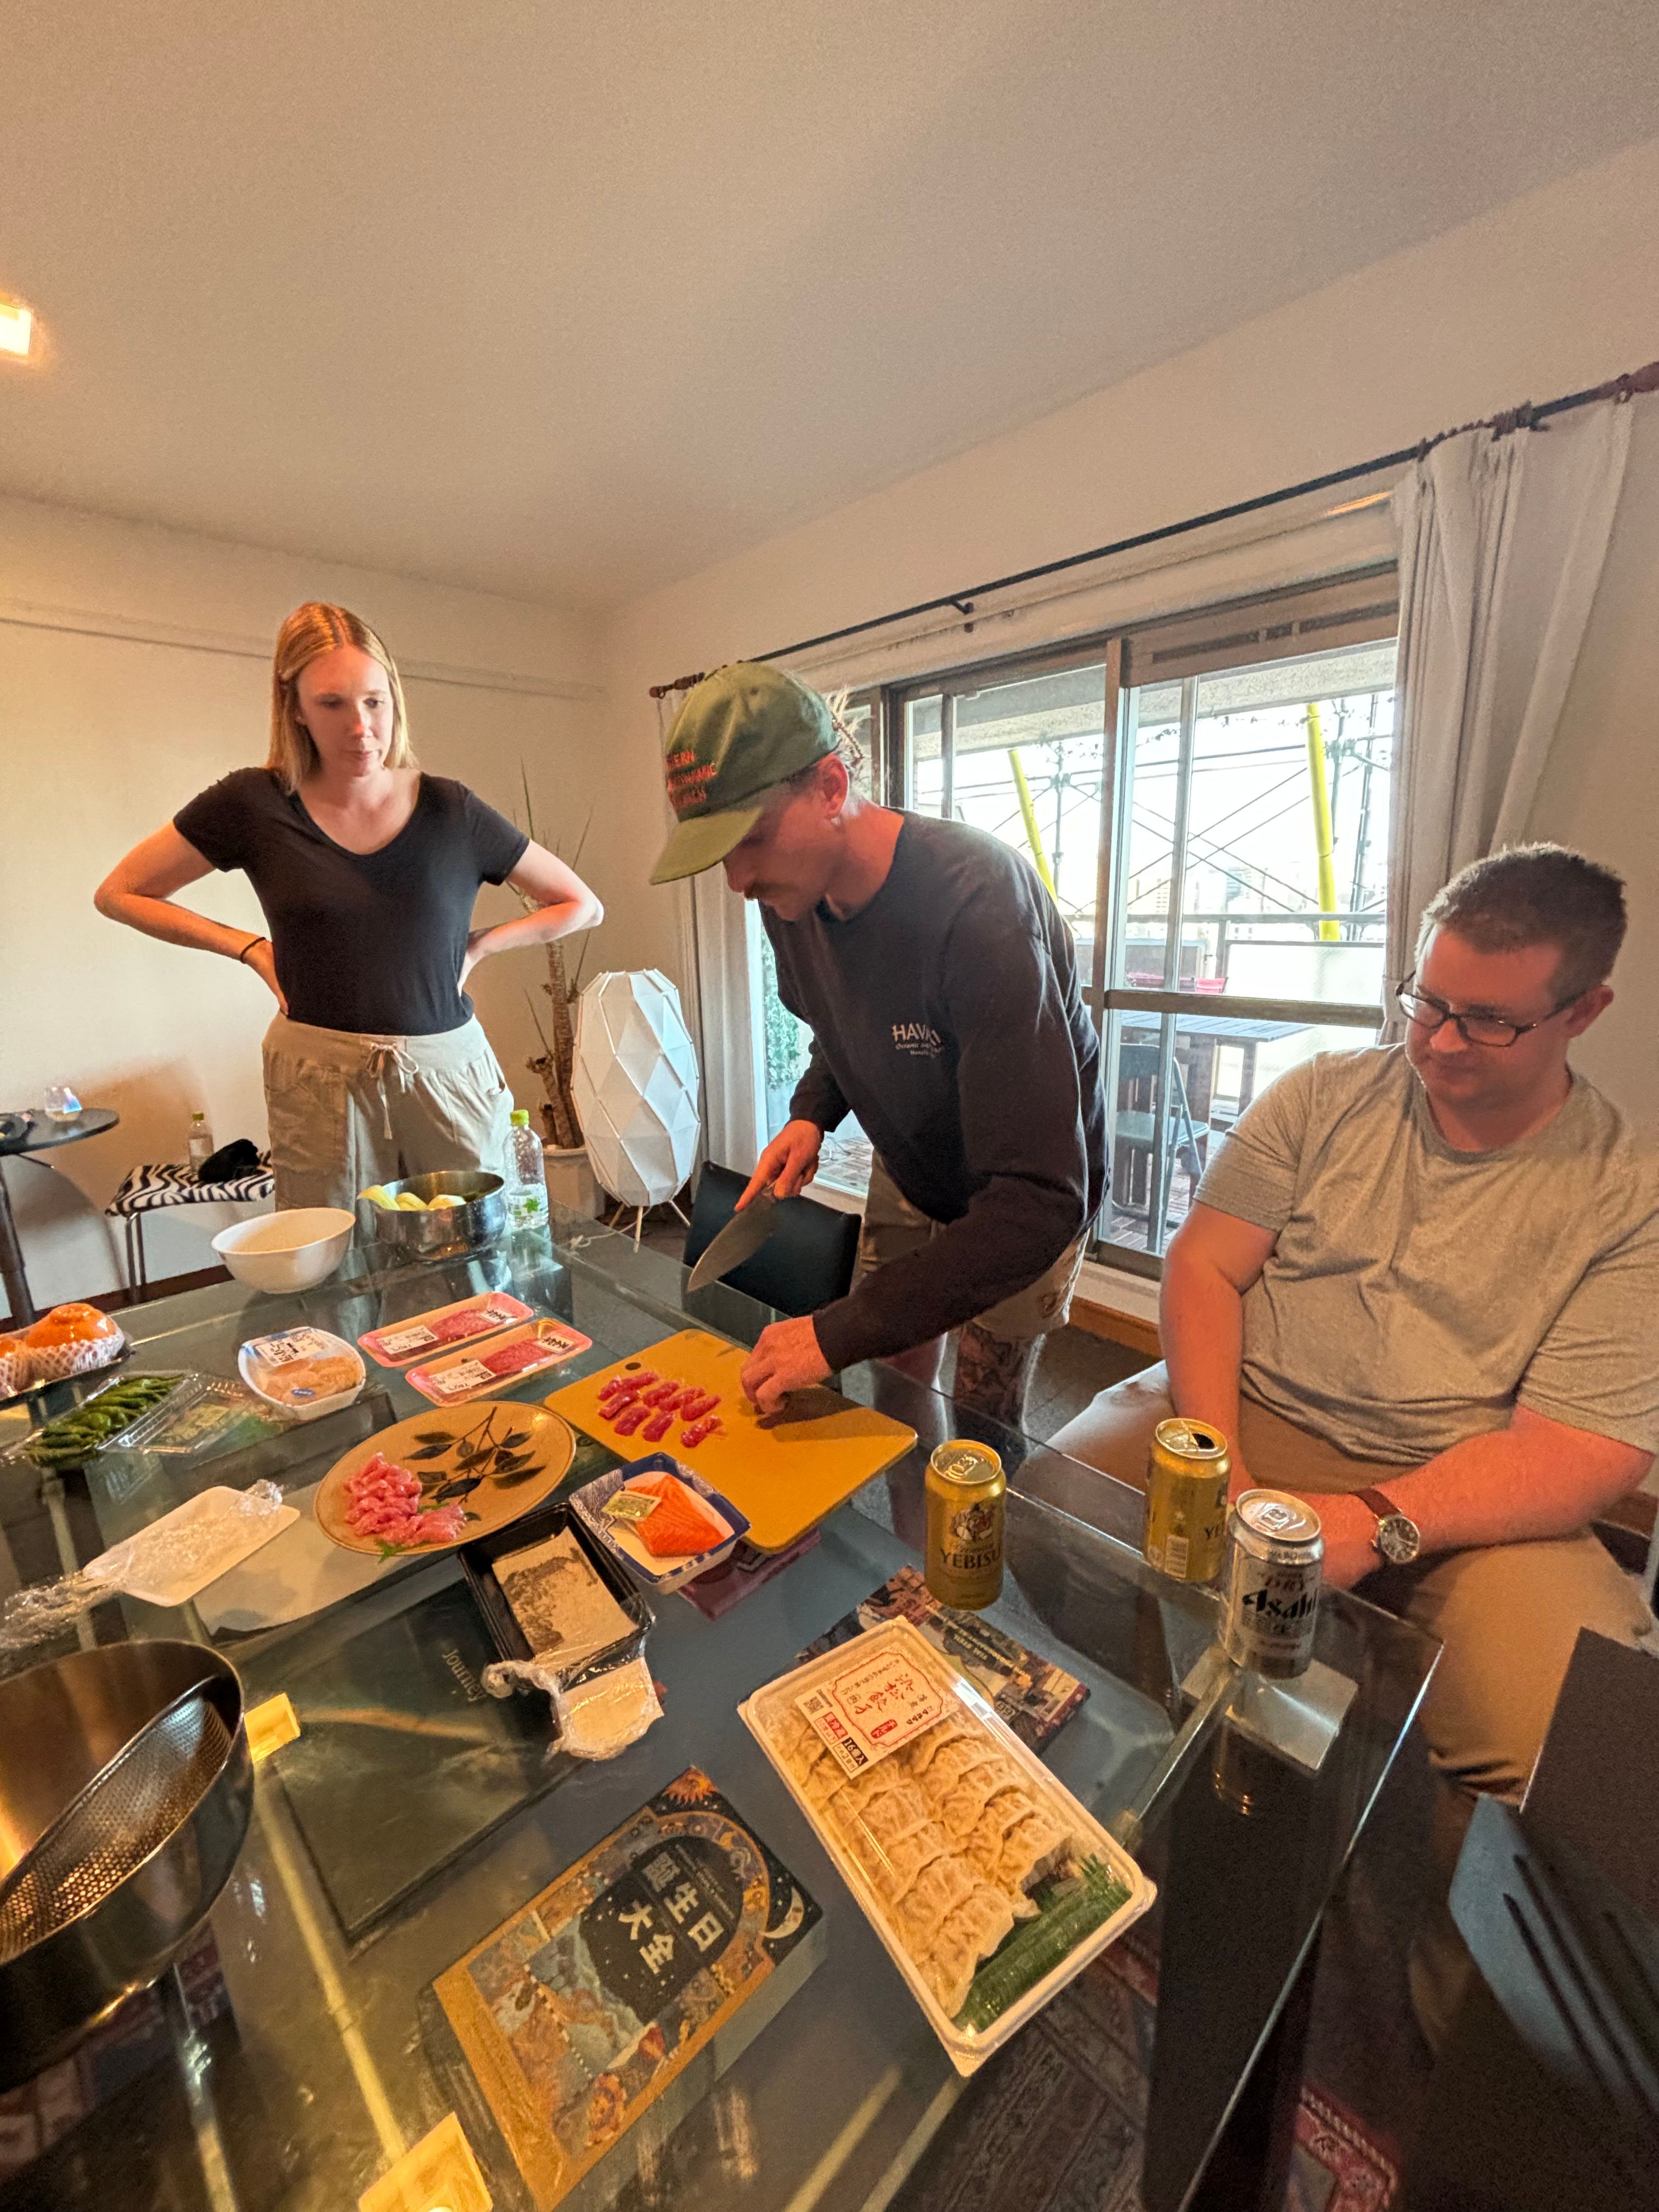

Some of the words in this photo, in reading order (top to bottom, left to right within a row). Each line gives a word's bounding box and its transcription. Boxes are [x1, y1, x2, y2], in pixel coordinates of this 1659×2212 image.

[442, 1649, 487, 1701] Journey
[844, 1739, 866, 1764] 16個入
[641, 1852, 725, 1952] 誕生日
[618, 1900, 674, 1974] 大全
